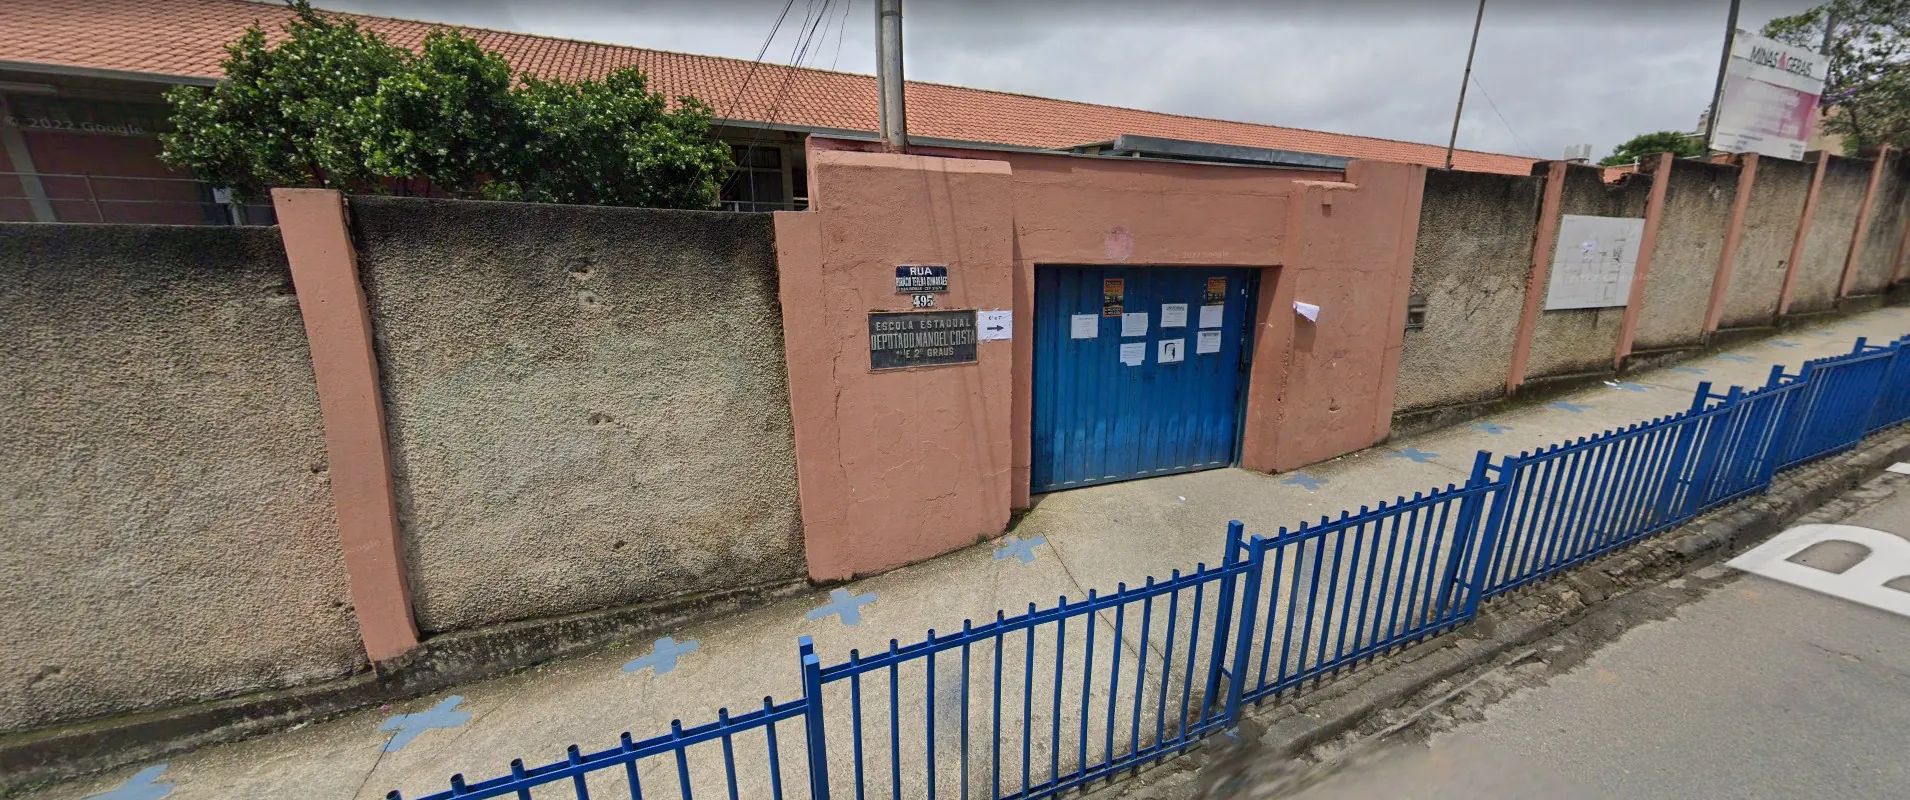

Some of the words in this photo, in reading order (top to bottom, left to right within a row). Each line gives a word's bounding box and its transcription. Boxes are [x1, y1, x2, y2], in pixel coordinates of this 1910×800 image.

[1751, 45, 1779, 68] MINAS
[910, 267, 933, 276] RUA
[913, 295, 934, 308] 495
[876, 321, 914, 331] ESCOLA
[920, 317, 971, 329] ESTADUAL
[871, 333, 915, 351] DEPUTADO
[950, 328, 976, 346] COSTA
[927, 346, 954, 357] GRAUS
